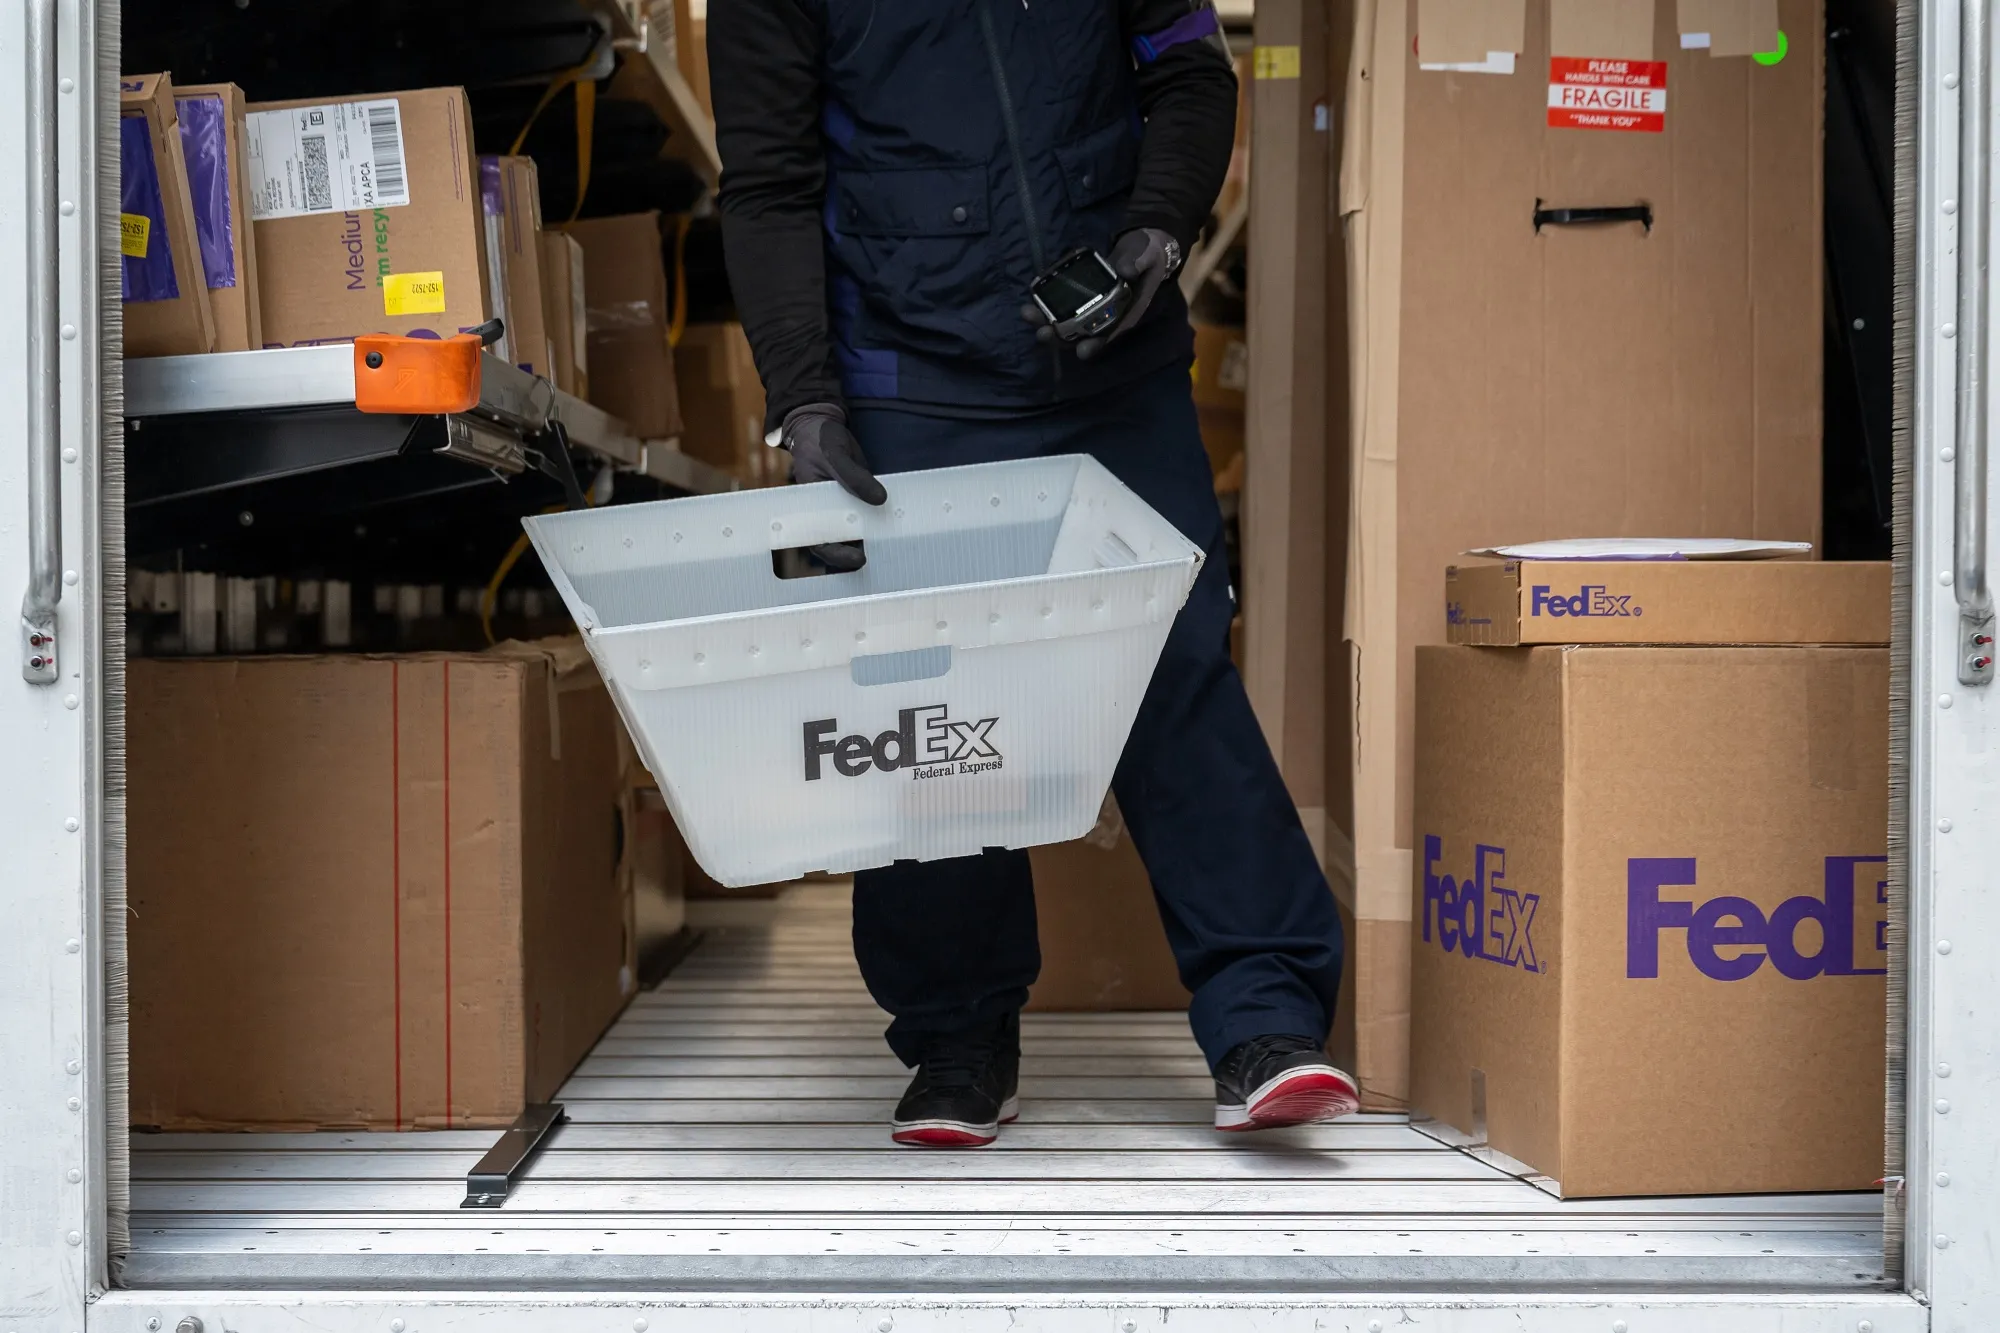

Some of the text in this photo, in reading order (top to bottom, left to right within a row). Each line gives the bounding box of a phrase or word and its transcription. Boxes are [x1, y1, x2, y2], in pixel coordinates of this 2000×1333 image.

[1565, 72, 1651, 86] HANDLE WITH CARE
[1588, 61, 1628, 73] PLEASE
[1562, 87, 1652, 109] FRAGILE
[360, 161, 373, 189] APCA
[373, 207, 390, 253] recy
[1531, 585, 1631, 617] FedEx
[803, 703, 1000, 782] FedEx
[913, 759, 1004, 780] Federal Express
[1423, 834, 1540, 973] FedEx
[1627, 855, 1888, 981] FedE
